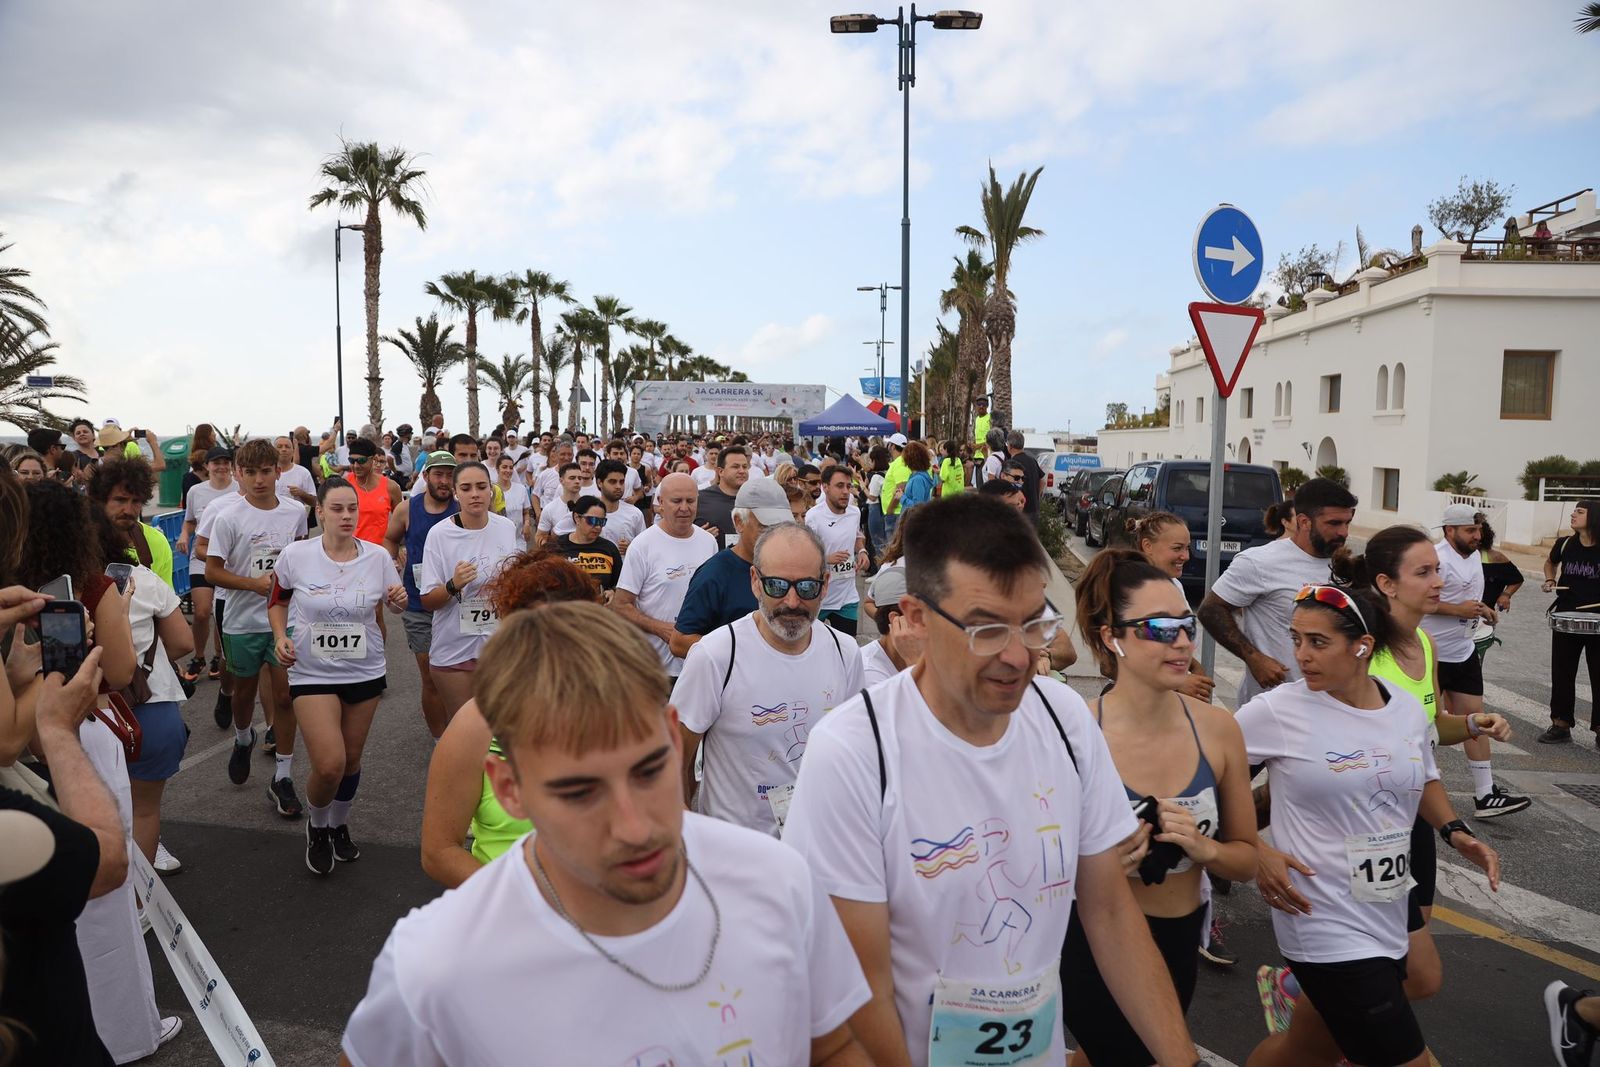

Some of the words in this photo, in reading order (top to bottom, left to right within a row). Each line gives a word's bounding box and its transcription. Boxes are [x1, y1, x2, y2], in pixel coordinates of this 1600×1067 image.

[1223, 542, 1238, 550] HNR
[256, 559, 277, 570] 12
[316, 634, 361, 648] 1017
[1378, 832, 1404, 841] CARRERA
[971, 988, 987, 997] 3A
[989, 985, 1035, 999] CARRERA
[975, 1018, 1034, 1055] 23
